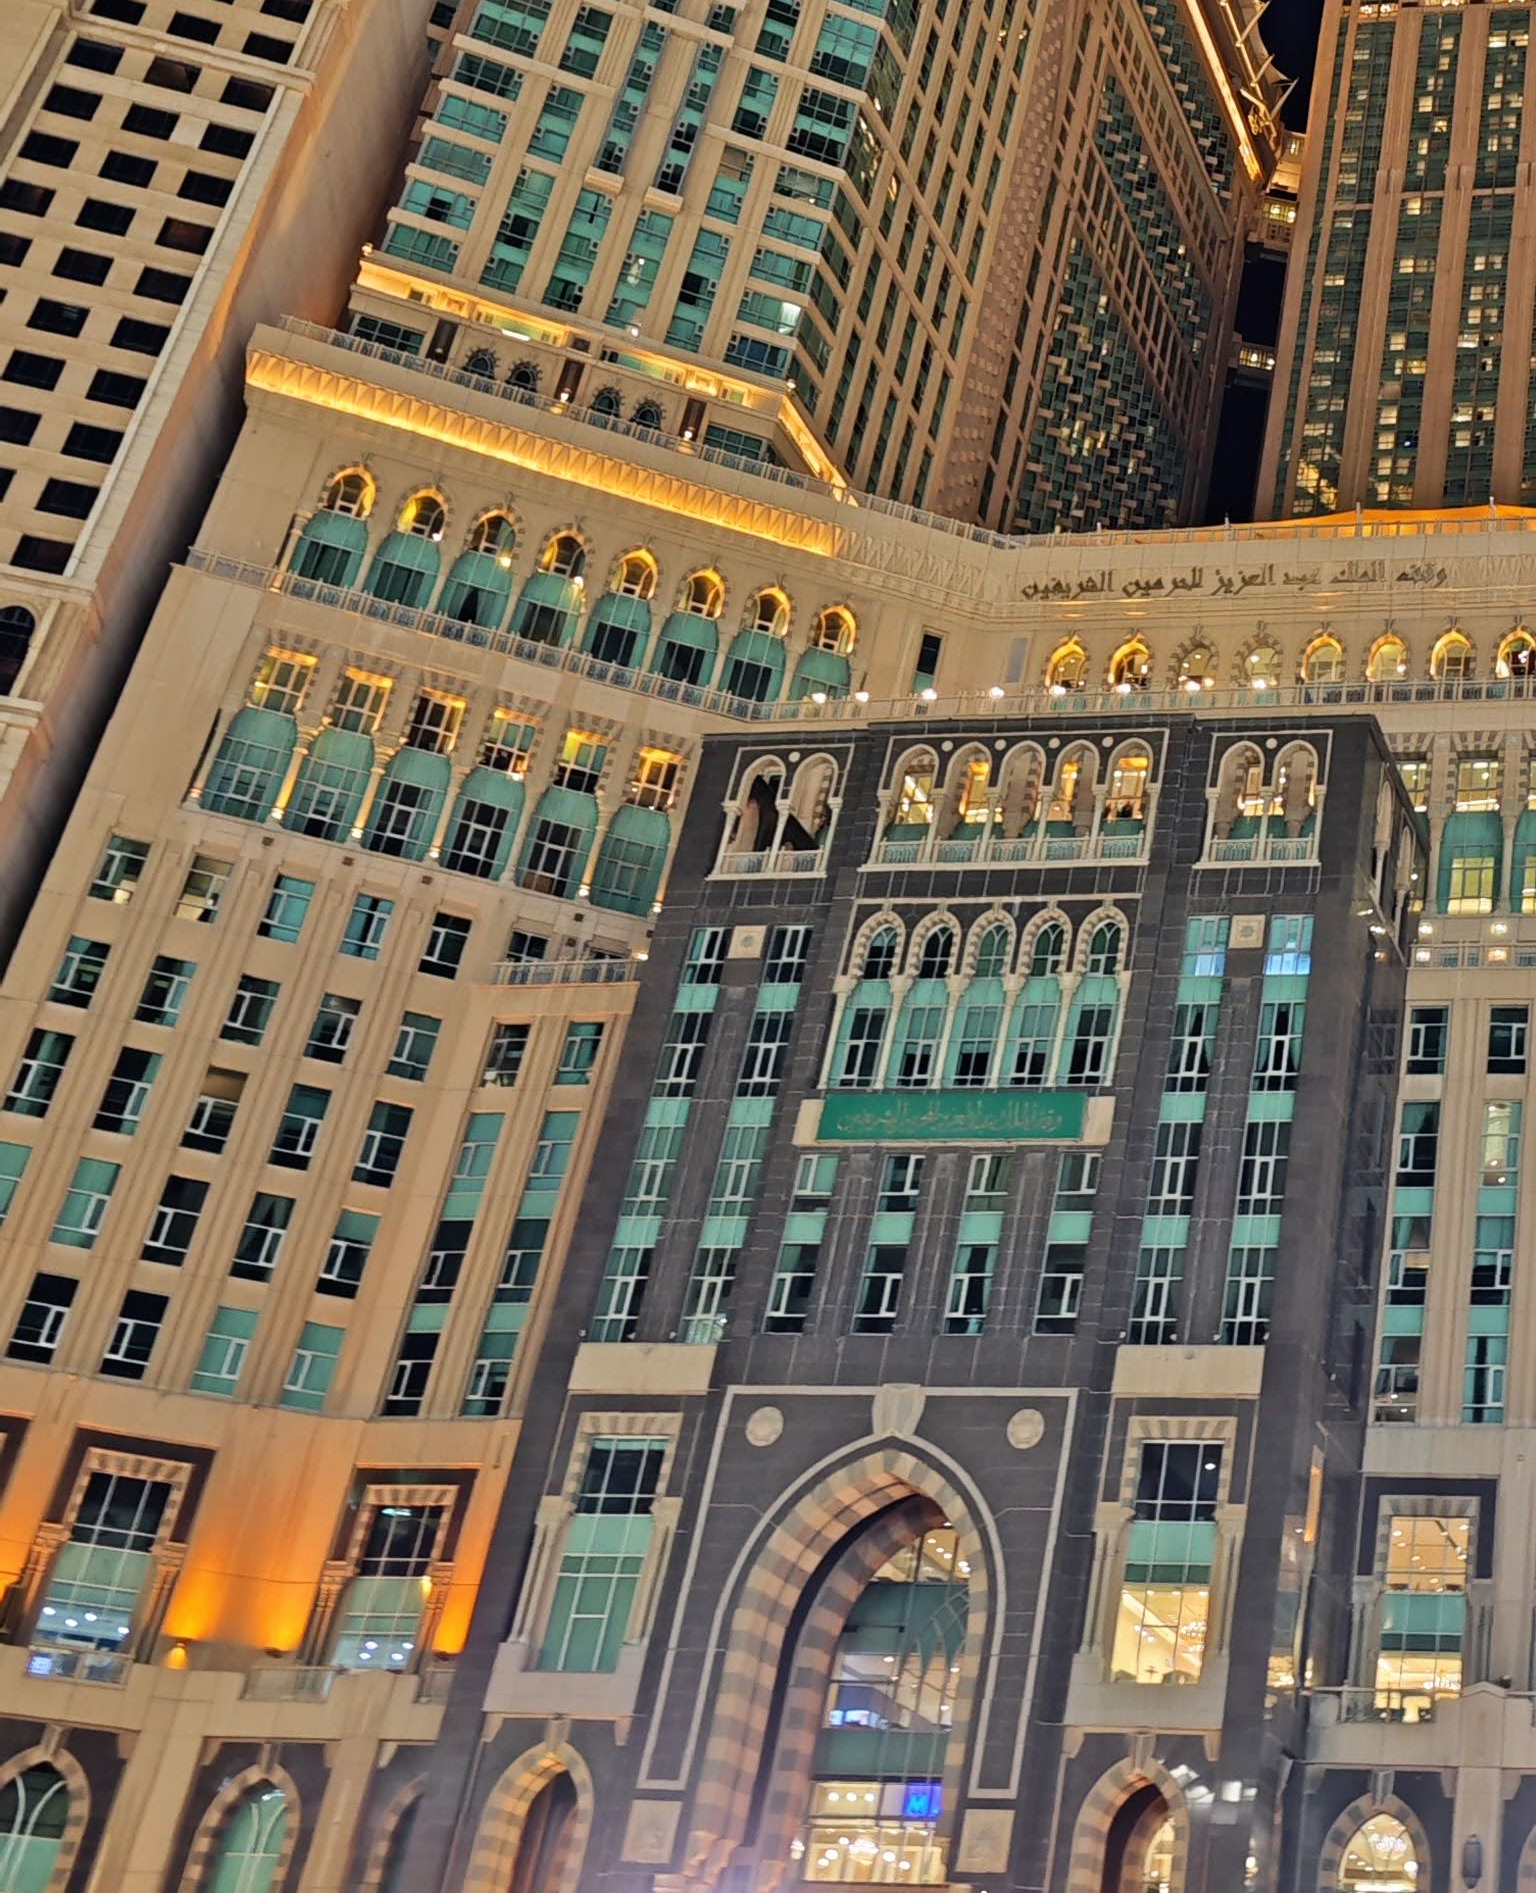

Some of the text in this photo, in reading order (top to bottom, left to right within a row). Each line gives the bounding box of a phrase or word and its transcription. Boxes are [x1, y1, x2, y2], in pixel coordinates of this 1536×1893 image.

[1021, 569, 1114, 600] الشريفين
[1121, 566, 1203, 597] للحرمين
[1329, 559, 1386, 585] الملك
